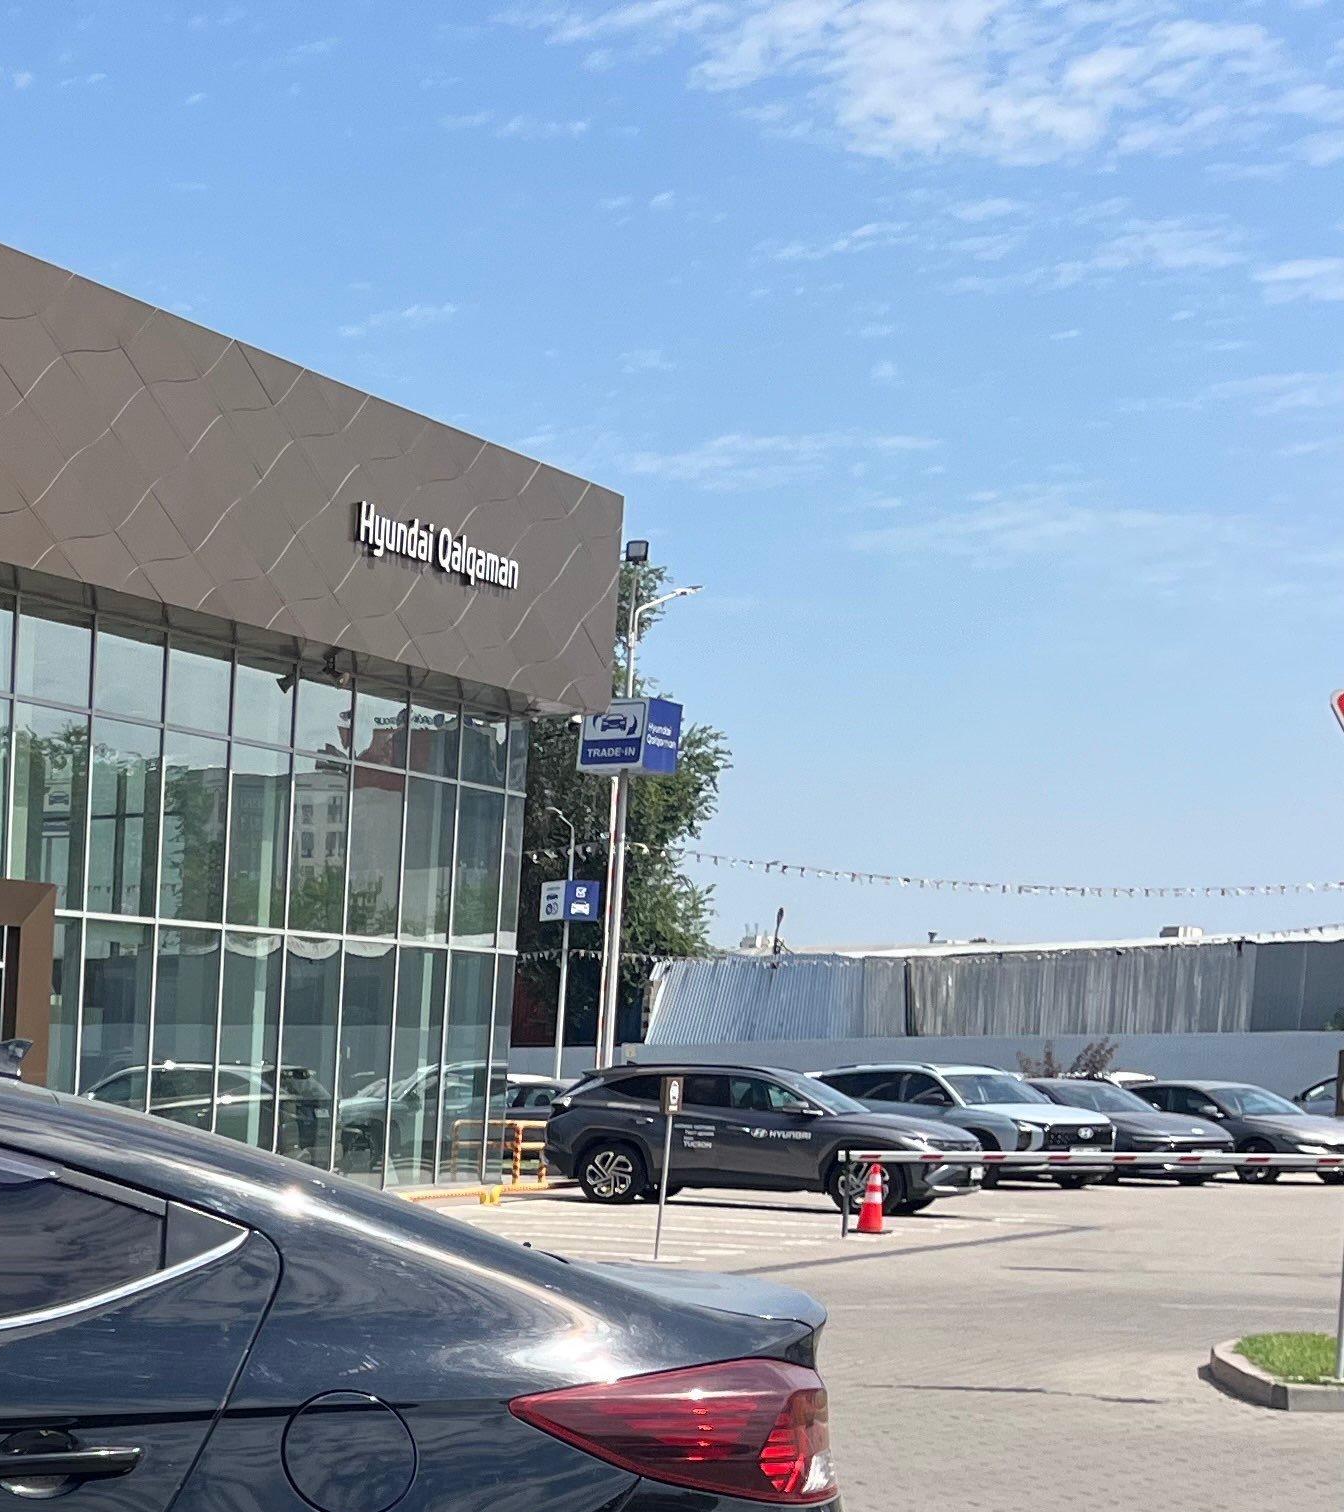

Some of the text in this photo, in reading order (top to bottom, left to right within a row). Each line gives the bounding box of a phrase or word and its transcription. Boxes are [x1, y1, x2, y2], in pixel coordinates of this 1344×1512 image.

[359, 500, 520, 589] Hyundai Qalqaman
[587, 746, 636, 758] TRADE-IN
[769, 1129, 812, 1140] HYUNDAI
